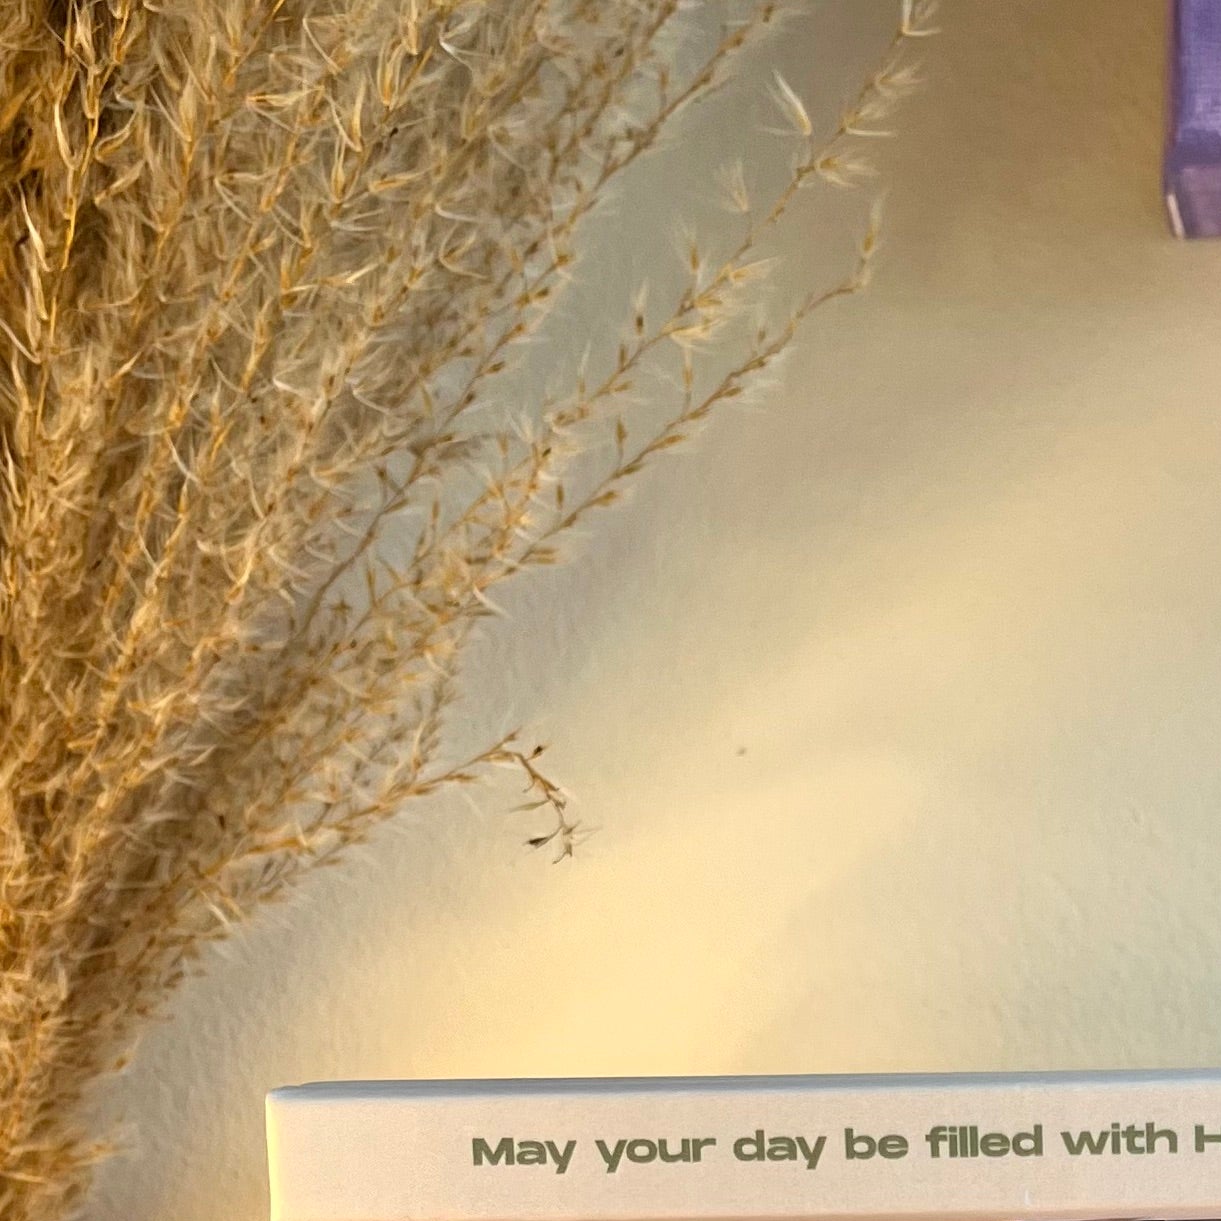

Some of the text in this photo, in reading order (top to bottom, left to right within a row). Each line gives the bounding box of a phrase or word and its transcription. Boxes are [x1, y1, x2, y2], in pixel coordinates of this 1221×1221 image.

[472, 1138, 576, 1174] May
[595, 1138, 716, 1173] your
[733, 1130, 827, 1170] day
[845, 1128, 908, 1160] be
[925, 1124, 1043, 1158] filled
[1060, 1122, 1177, 1155] with
